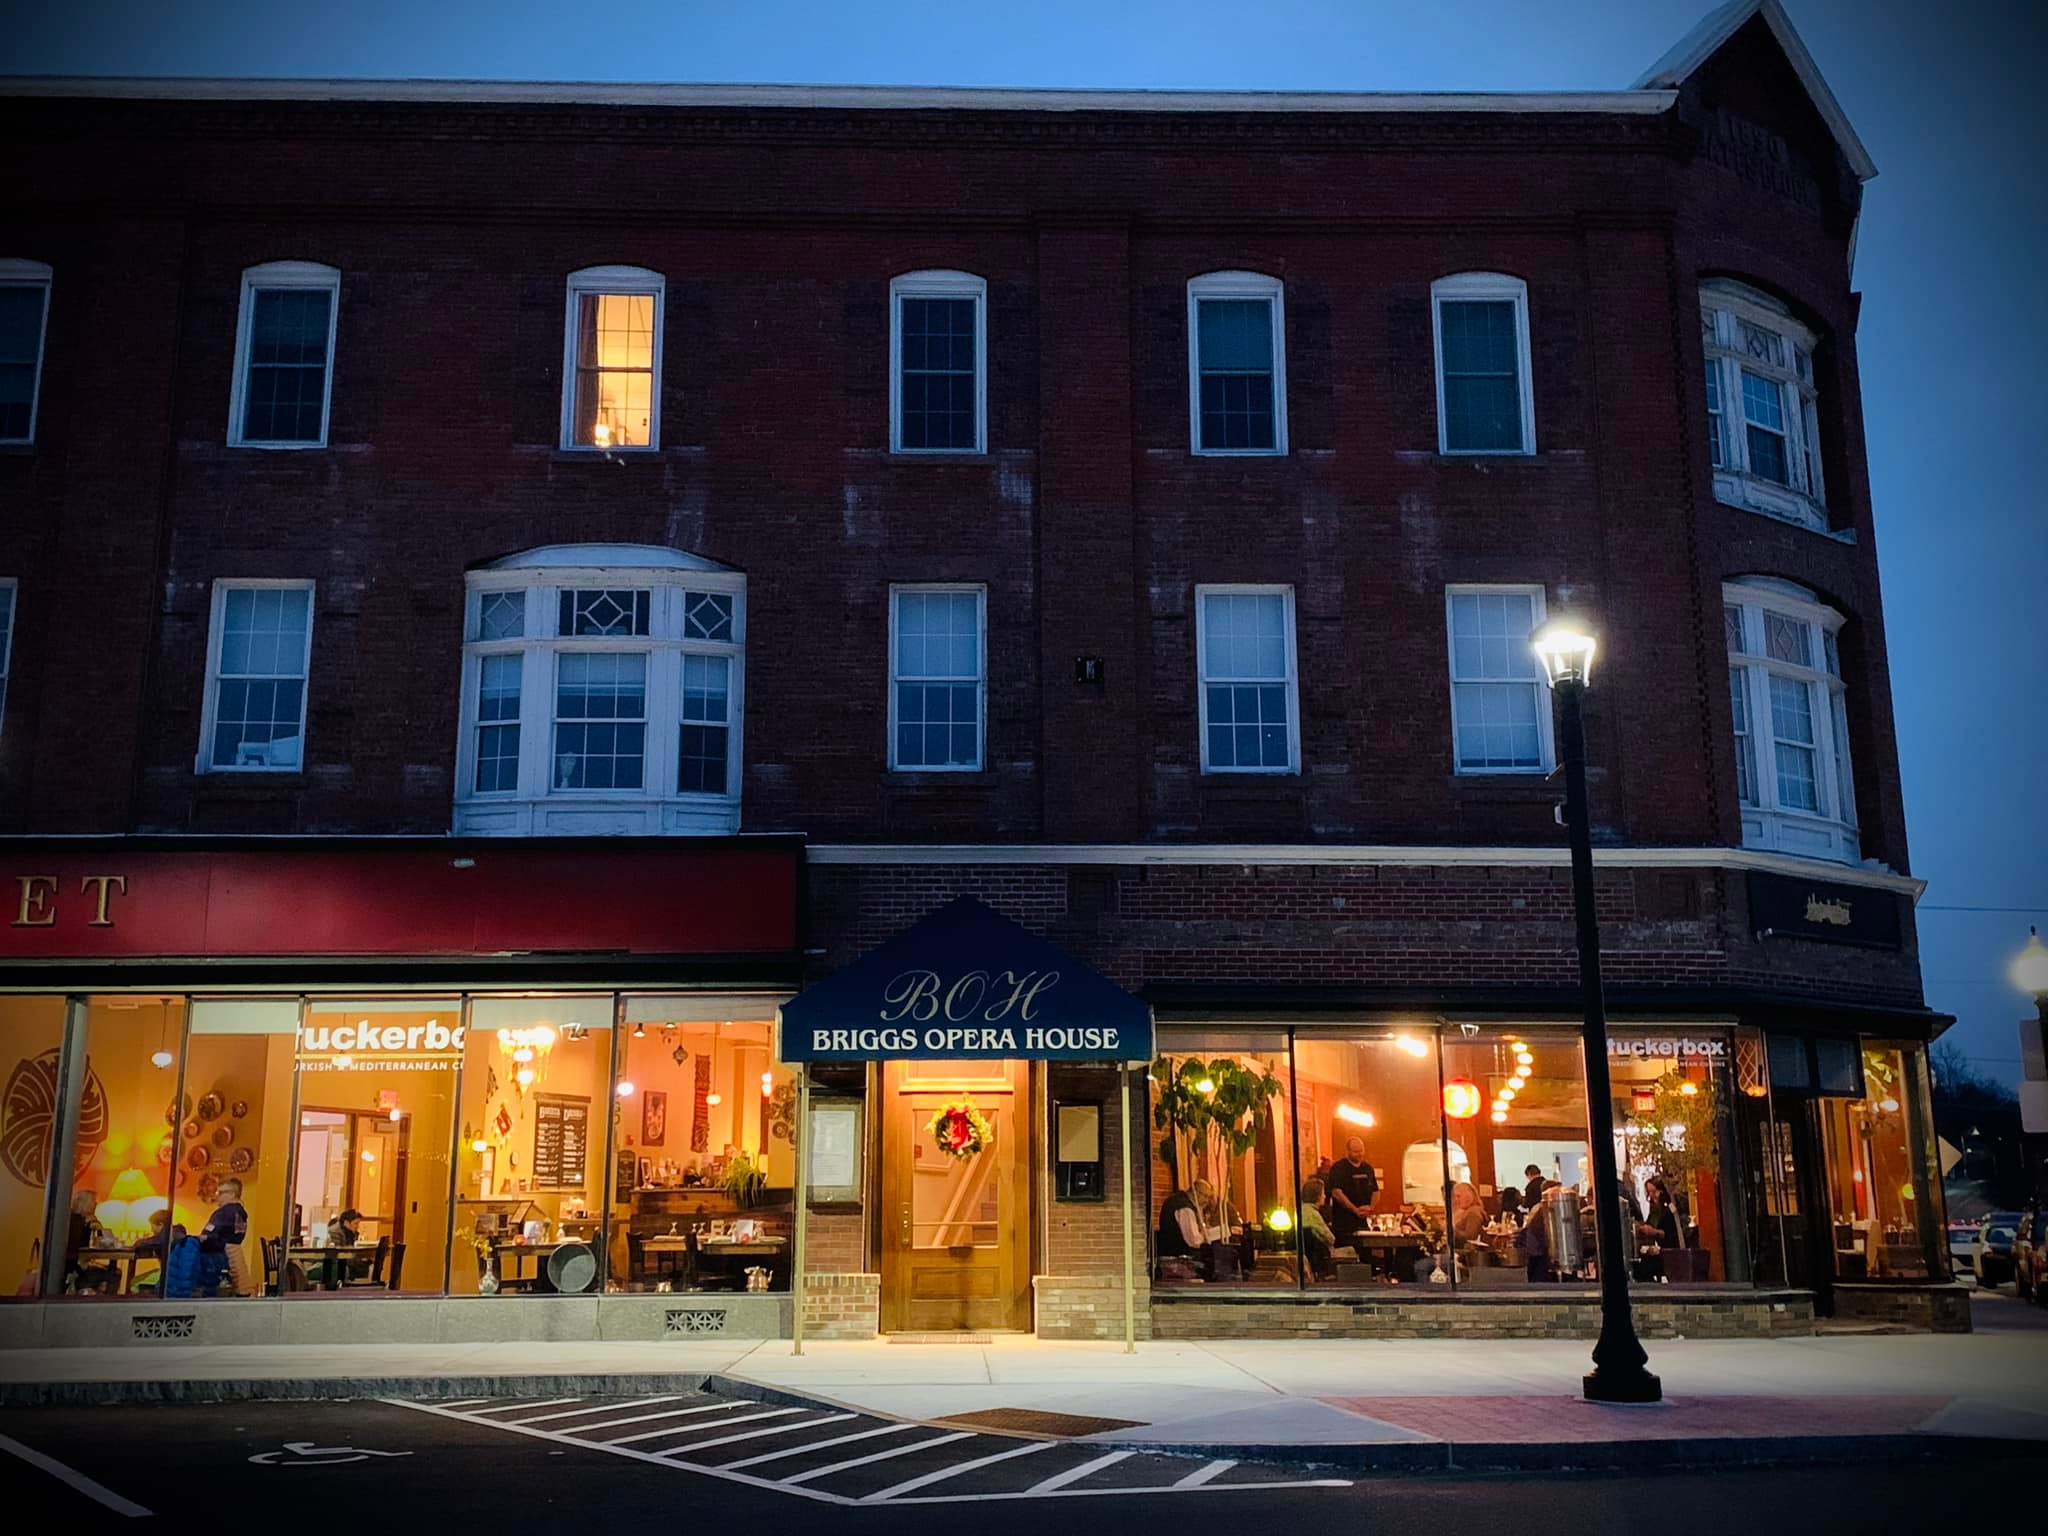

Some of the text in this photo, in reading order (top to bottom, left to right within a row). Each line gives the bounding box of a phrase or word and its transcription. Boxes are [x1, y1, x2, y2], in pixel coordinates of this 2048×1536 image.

[880, 969, 1060, 1022] BOH
[812, 1027, 1120, 1051] BRIGGS OPERA HOUSE
[1606, 1037, 1725, 1056] tuckerbox
[350, 1060, 448, 1072] MEDITERRANEAN
